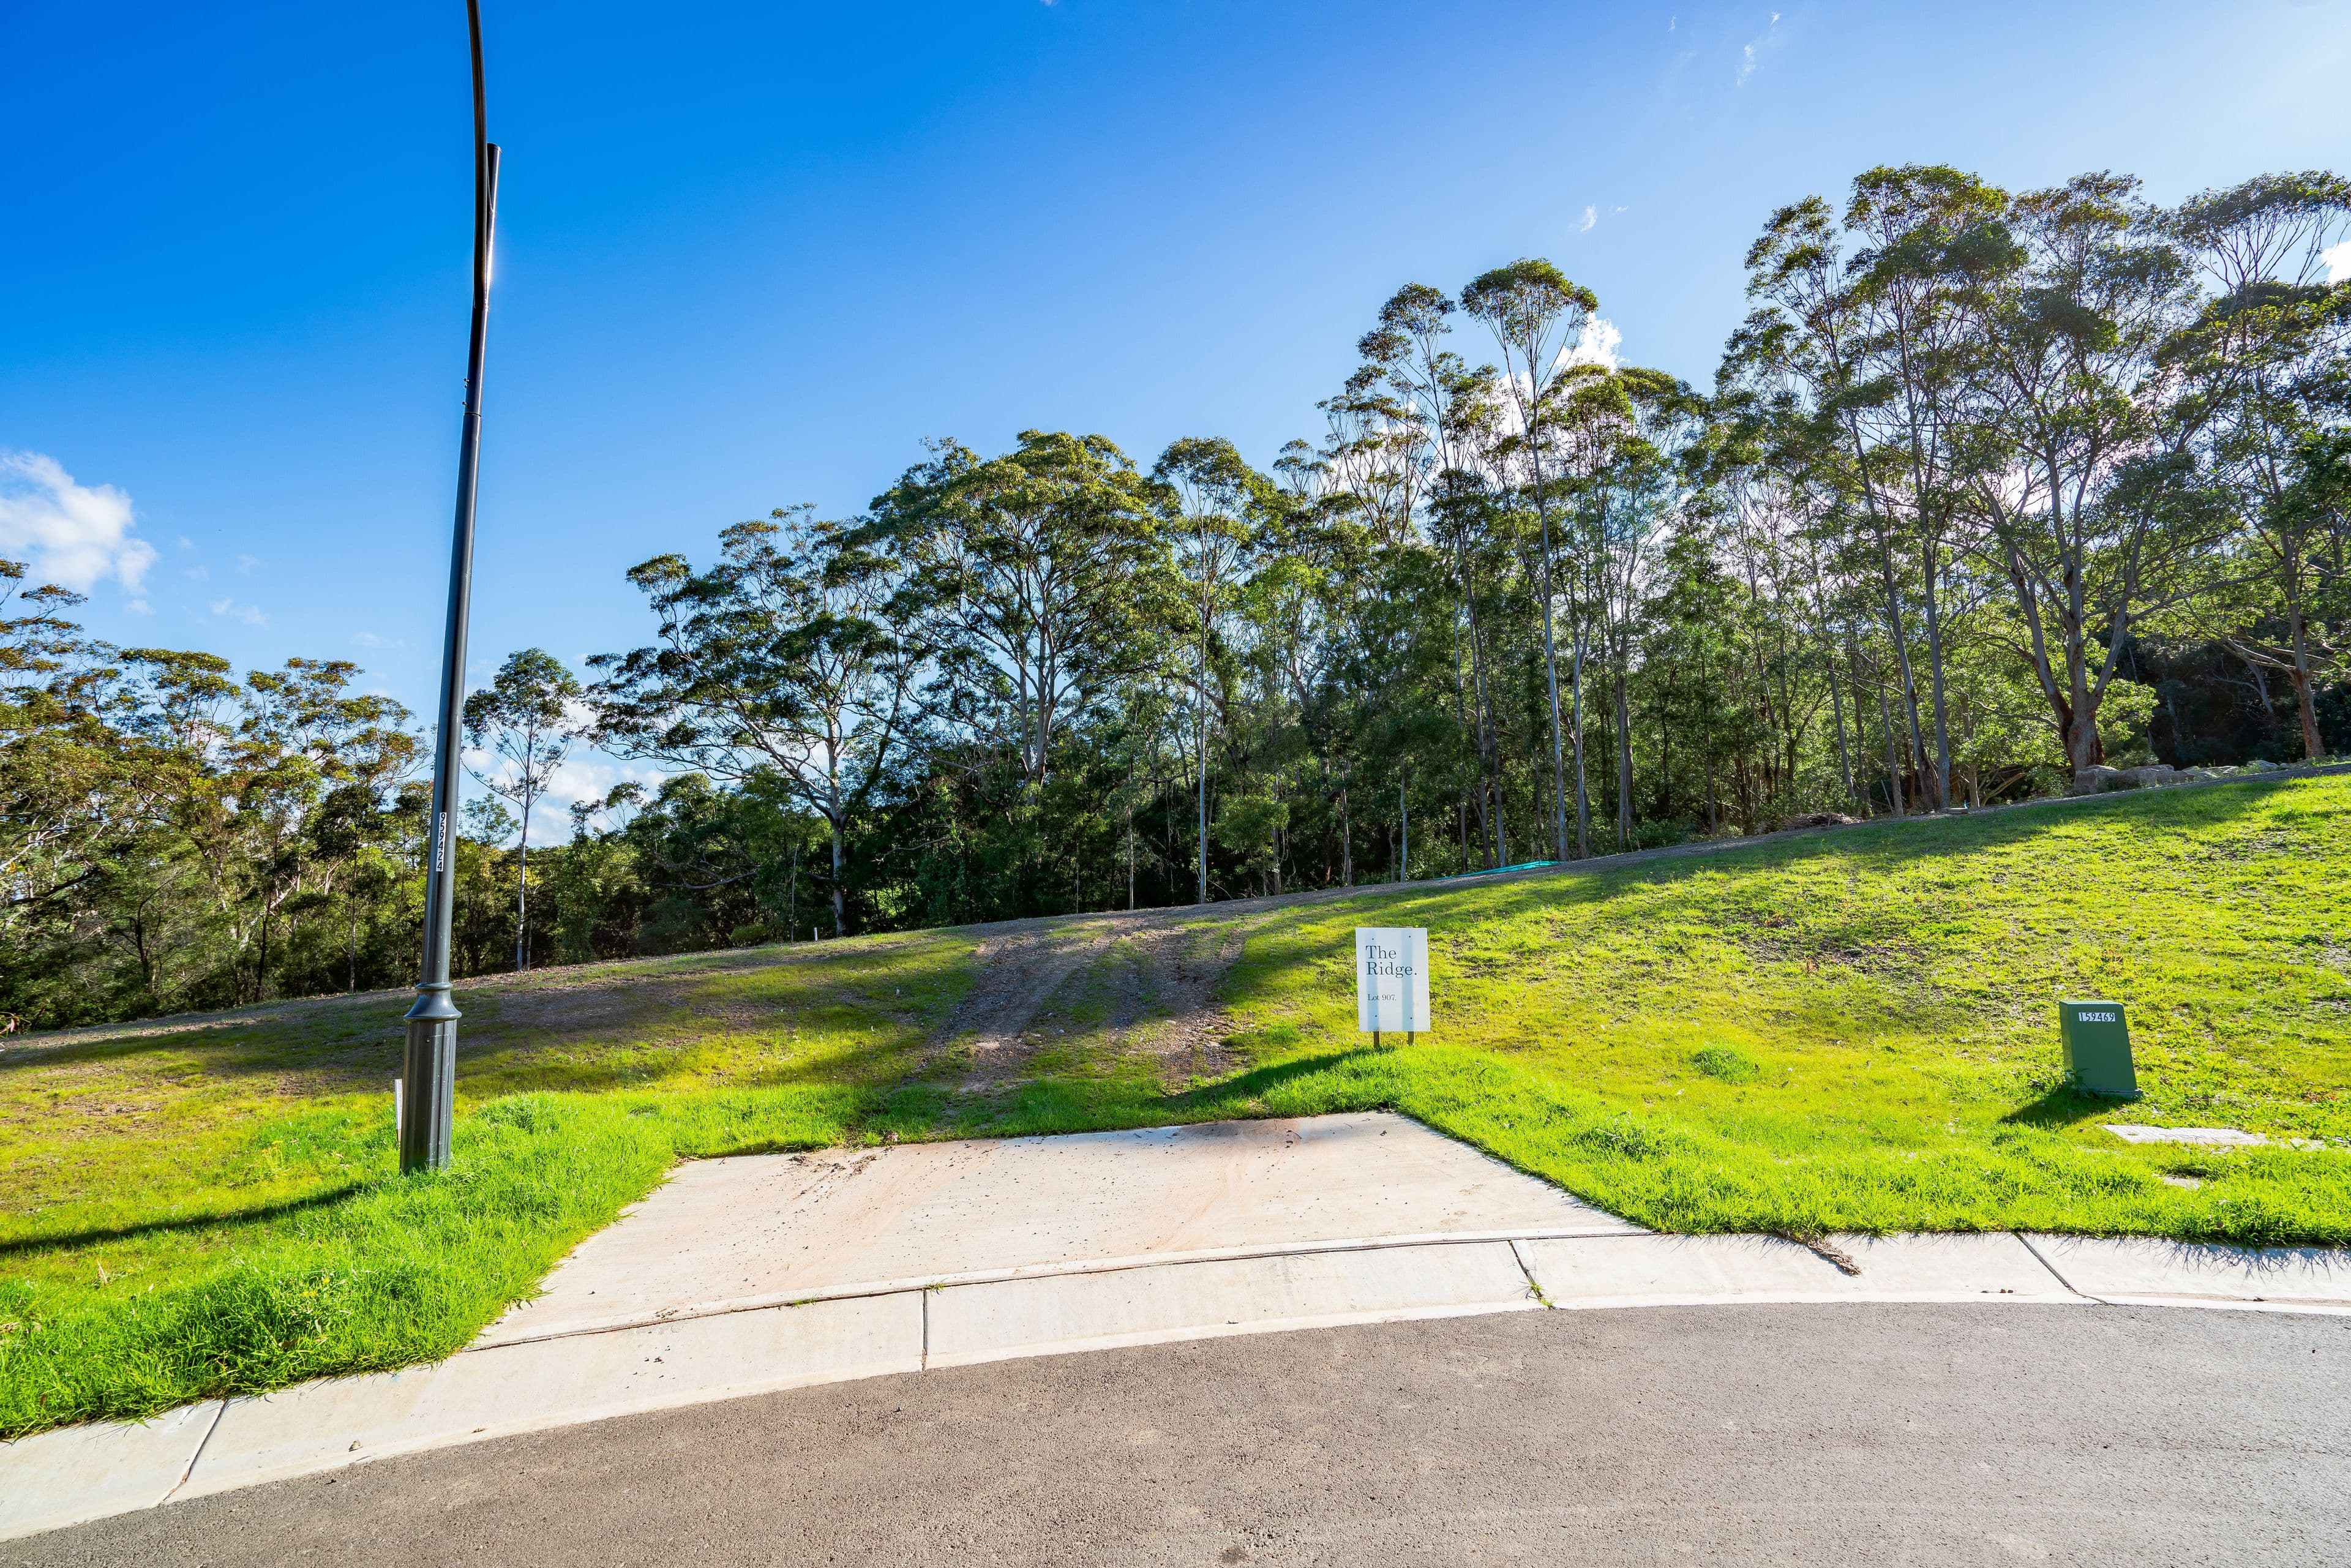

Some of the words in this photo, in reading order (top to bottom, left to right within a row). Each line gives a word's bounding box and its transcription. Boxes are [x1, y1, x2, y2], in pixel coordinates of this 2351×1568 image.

[437, 812, 446, 871] 959424
[1365, 945, 1397, 959] The
[1366, 961, 1417, 979] Ridge.
[2080, 1013, 2115, 1022] 159469
